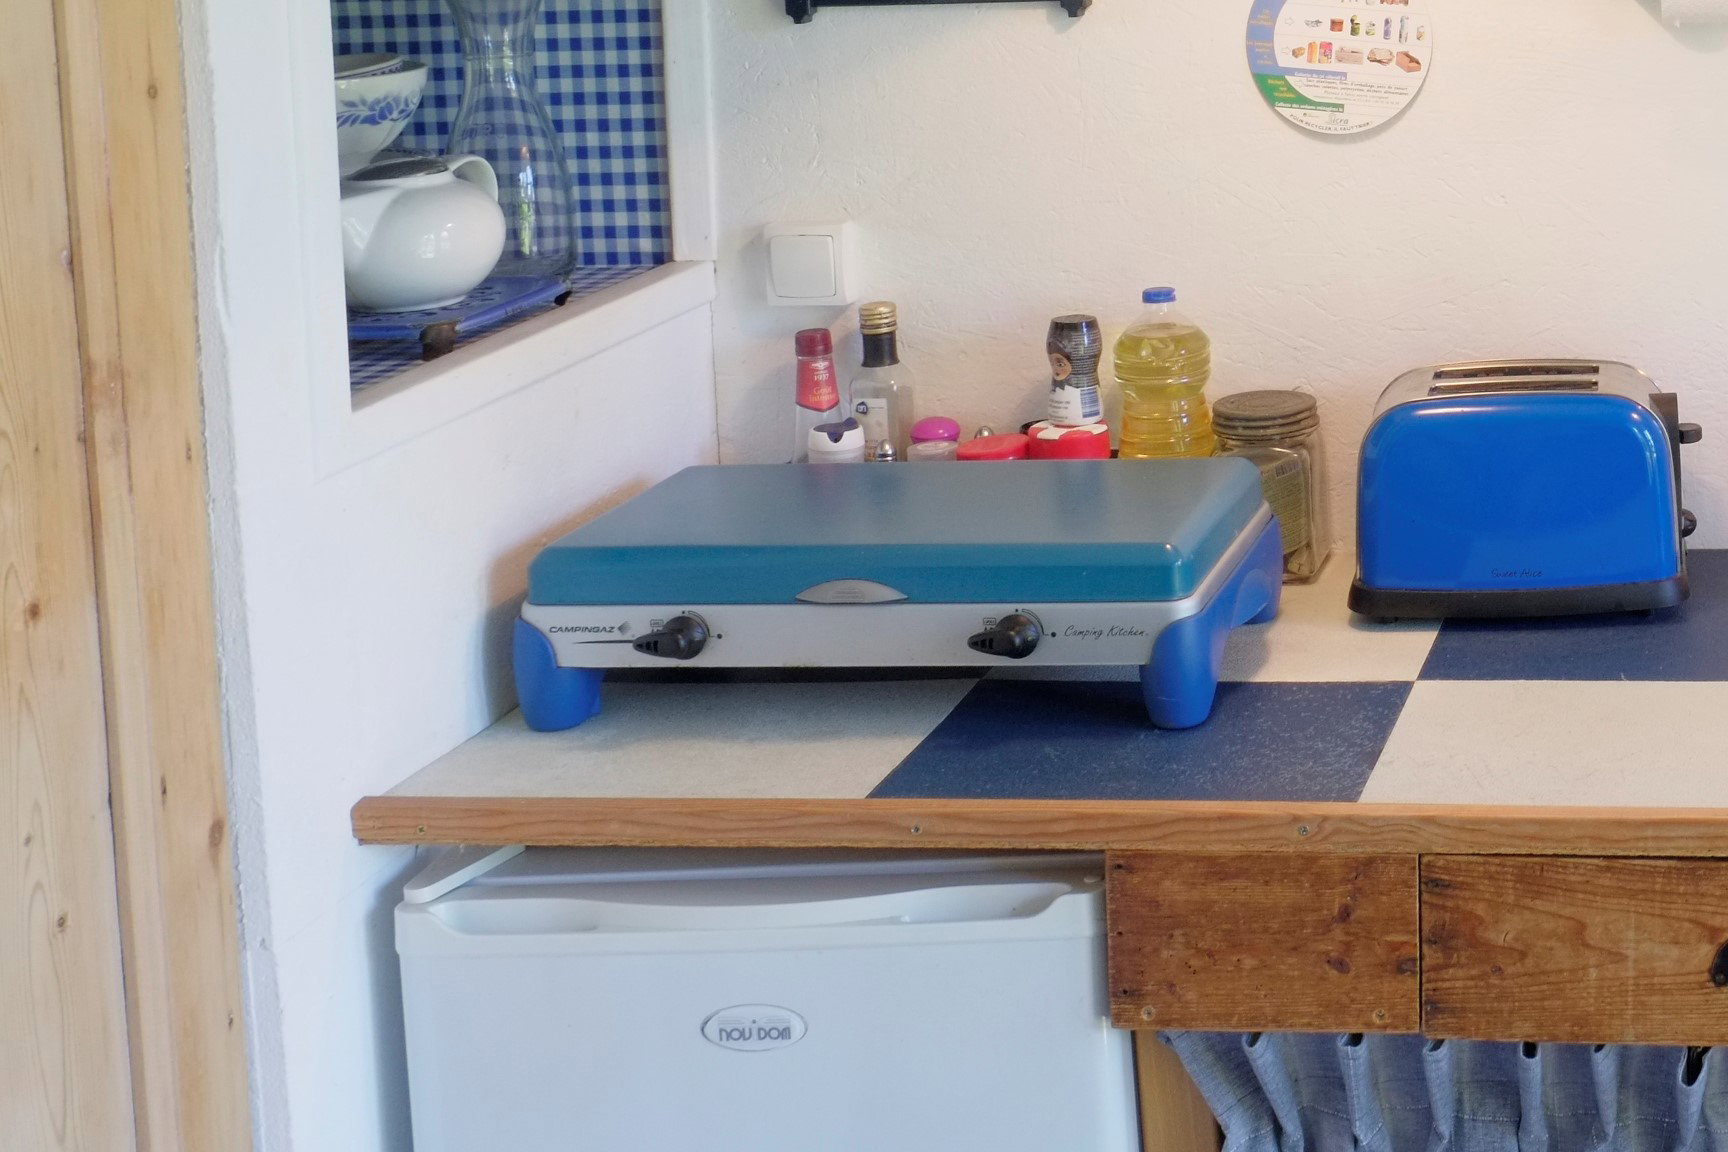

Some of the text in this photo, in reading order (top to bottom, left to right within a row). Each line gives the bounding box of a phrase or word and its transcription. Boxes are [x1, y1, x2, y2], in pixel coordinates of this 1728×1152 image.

[1520, 567, 1543, 578] Alice
[549, 625, 616, 634] CAMPINGAZ
[1064, 624, 1103, 641] Camping
